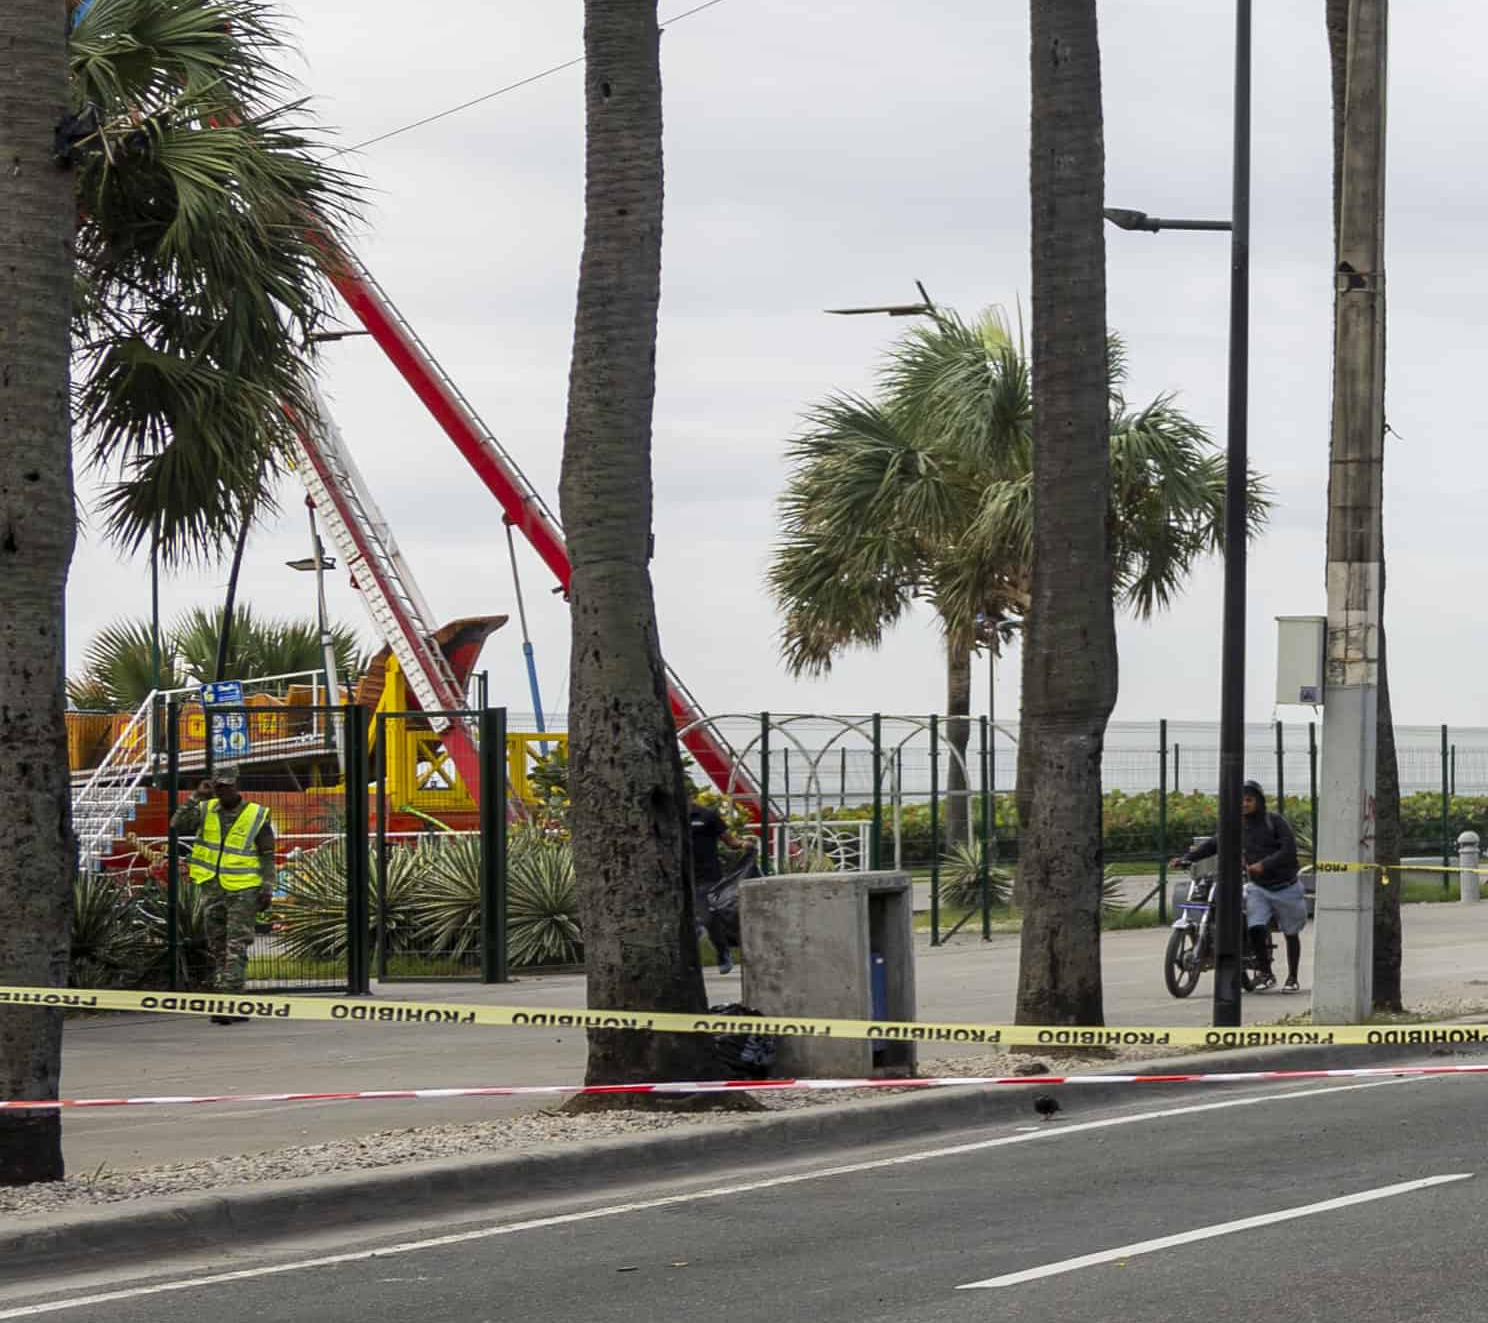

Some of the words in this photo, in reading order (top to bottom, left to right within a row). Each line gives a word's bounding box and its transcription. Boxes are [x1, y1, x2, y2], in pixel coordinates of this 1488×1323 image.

[141, 996, 290, 1019] PROHIBIDO
[331, 1004, 476, 1026] PROHIBIDO
[512, 1013, 653, 1029] PROHIBIDO
[694, 1021, 831, 1037] PROHIBIDO
[867, 1026, 1001, 1043] PROHIBIDO
[1038, 1030, 1170, 1046] PROHIBIDO
[1205, 1031, 1334, 1045] PROHIBIDO
